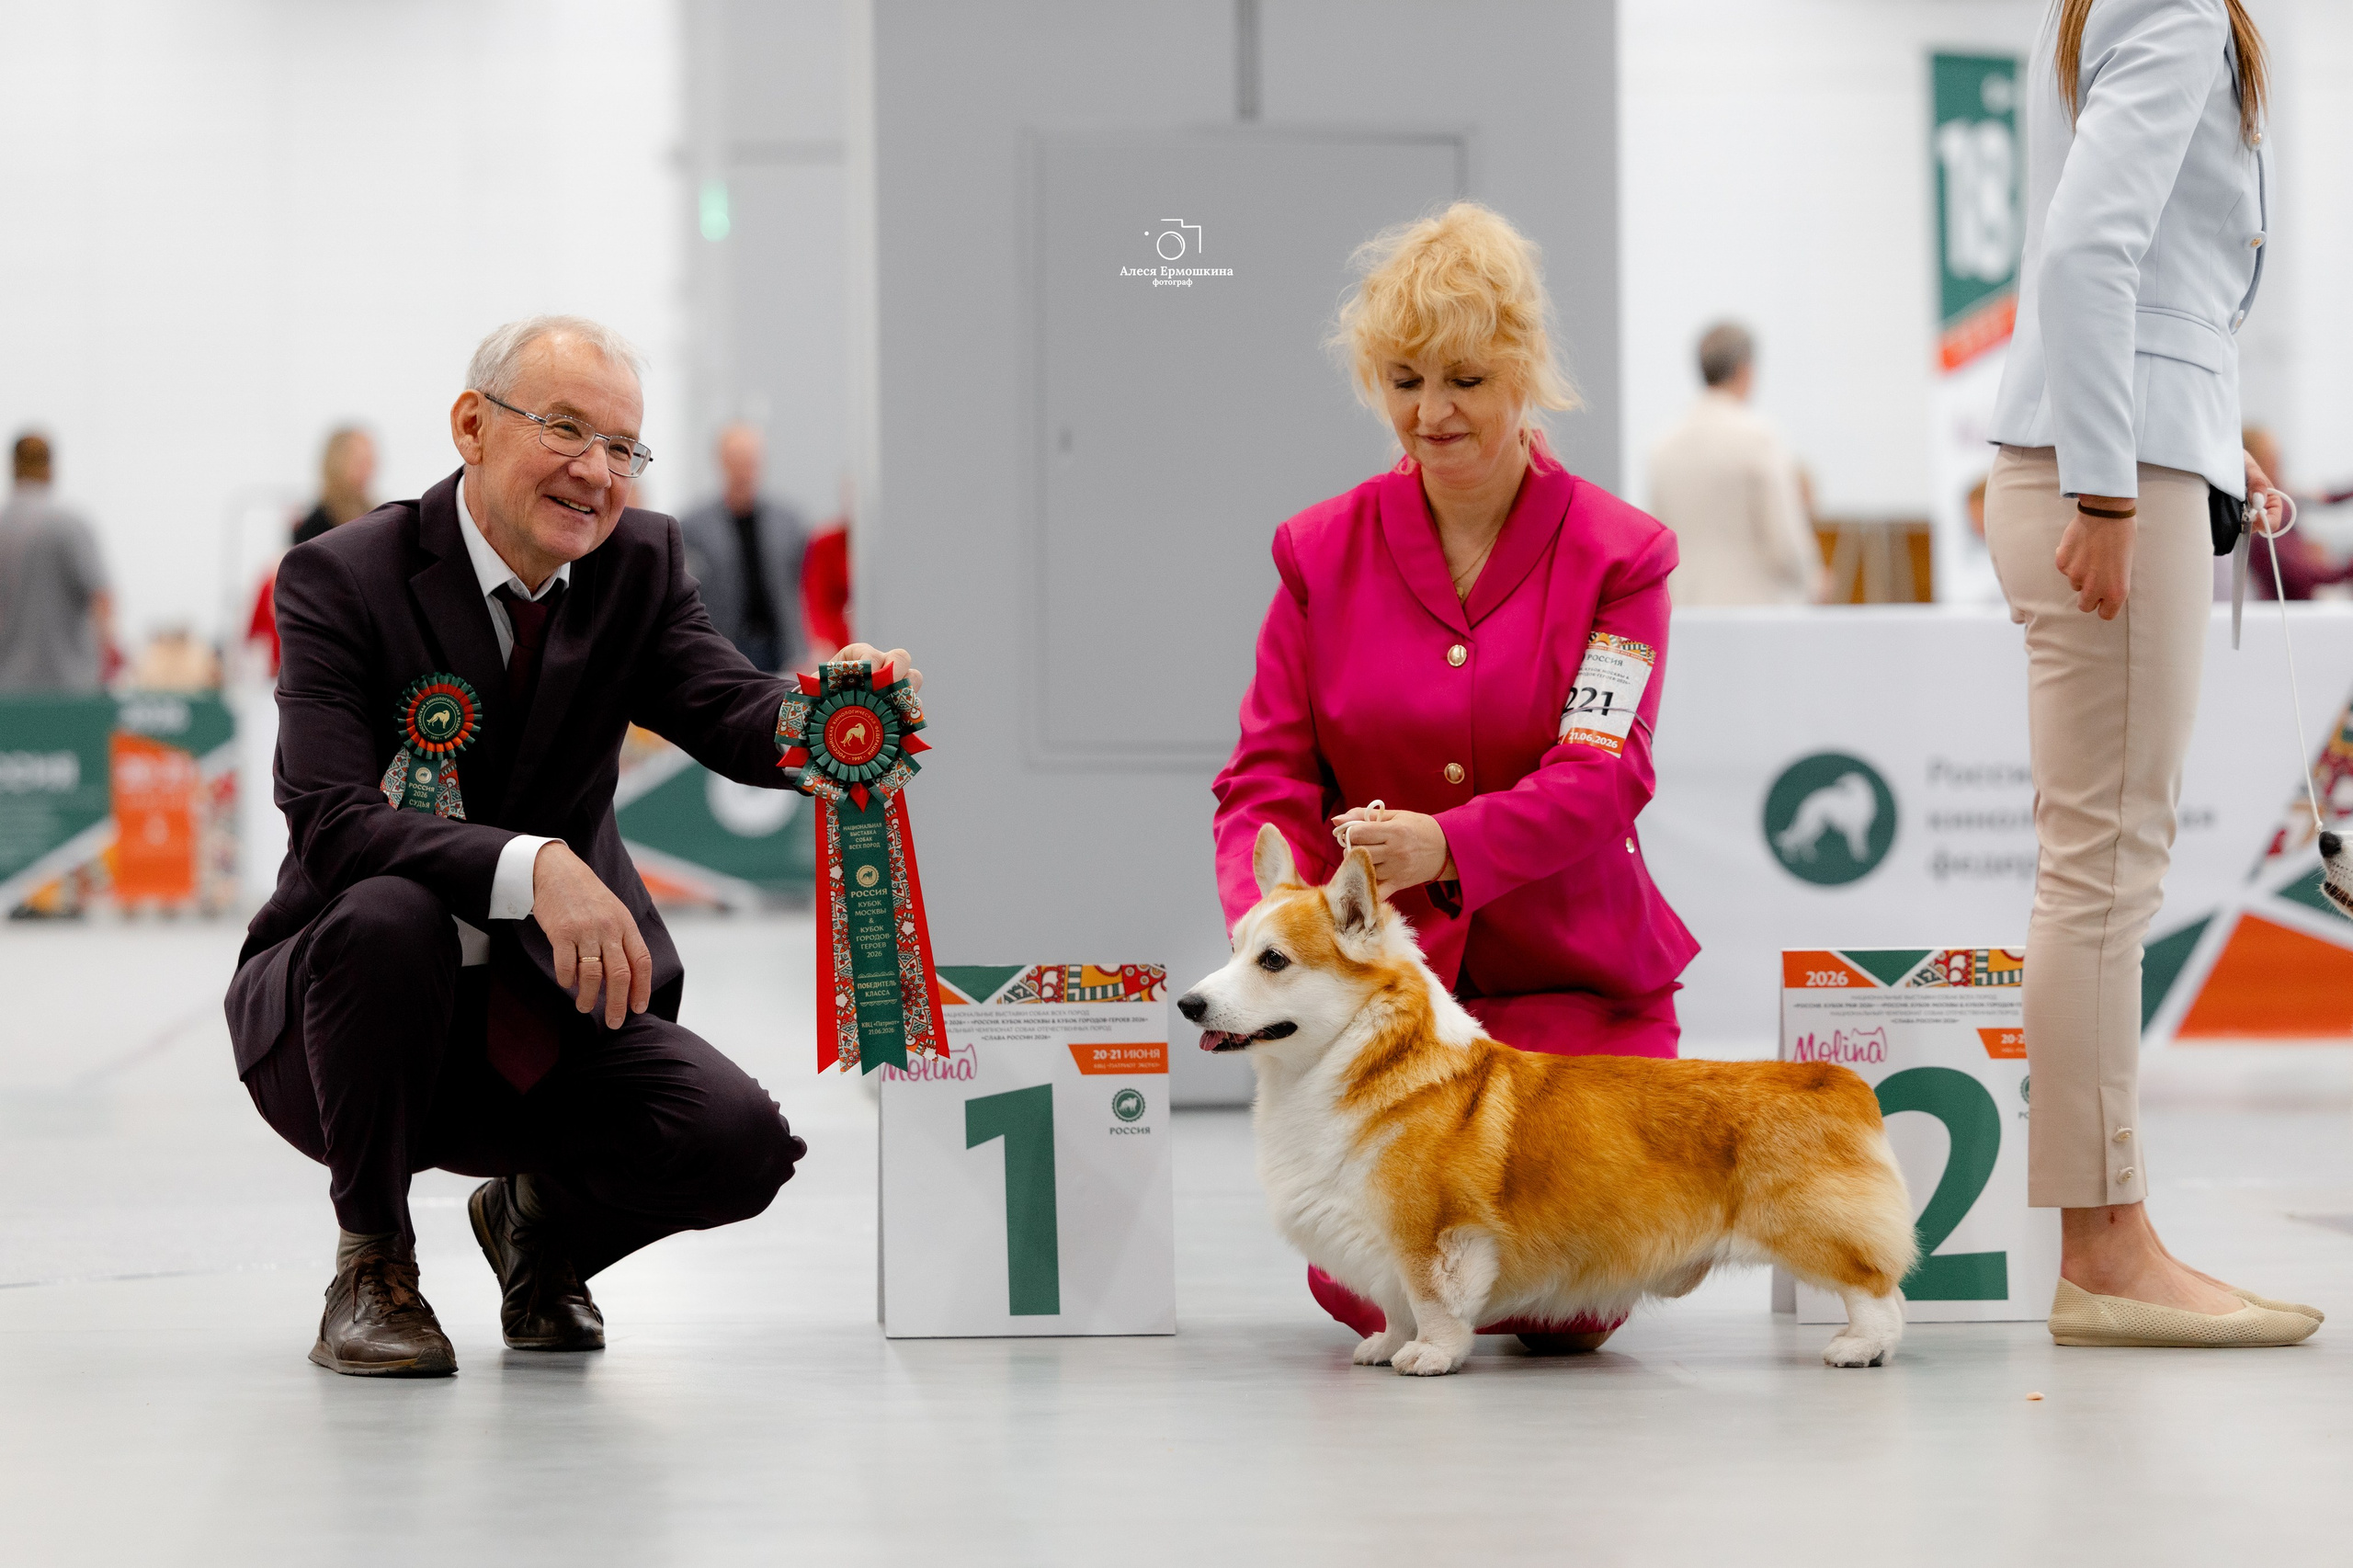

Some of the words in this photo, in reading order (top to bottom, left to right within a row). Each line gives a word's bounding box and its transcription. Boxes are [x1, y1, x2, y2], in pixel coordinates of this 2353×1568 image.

[1586, 654, 1623, 666] РОССИЯ
[1562, 687, 1614, 716] 221
[833, 710, 876, 724] КИНОЛОГИЧЕСКАЯ
[828, 725, 846, 759] РОССИЙСКАЯ
[868, 725, 881, 756] ФЕДЕРАЦИЯ
[1568, 732, 1618, 748] 21.06.2026
[409, 782, 435, 792] РОССИЯ
[409, 799, 430, 808] СУДЬЯ
[843, 823, 882, 831] НАЦИОНАЛЬНАЯ
[850, 888, 888, 898] РОССИЯ
[858, 900, 881, 908] КУБОК
[855, 908, 887, 916] МОСКВЫ
[860, 925, 883, 933] КУБОК
[856, 933, 892, 942] ГОРОДОВ-
[1805, 971, 1848, 986] 2026
[857, 980, 897, 990] ПОБЕДИТЕЛЬ
[865, 989, 891, 997] КЛАССА
[869, 1027, 895, 1035] 21.06.2026
[2001, 1033, 2025, 1044] 20-2
[1793, 1027, 1888, 1063] Molina
[1093, 1050, 1121, 1060] 20-21
[1123, 1049, 1160, 1059] ИЮНЯ
[1874, 1066, 2009, 1301] 2
[965, 1084, 1060, 1316] 1
